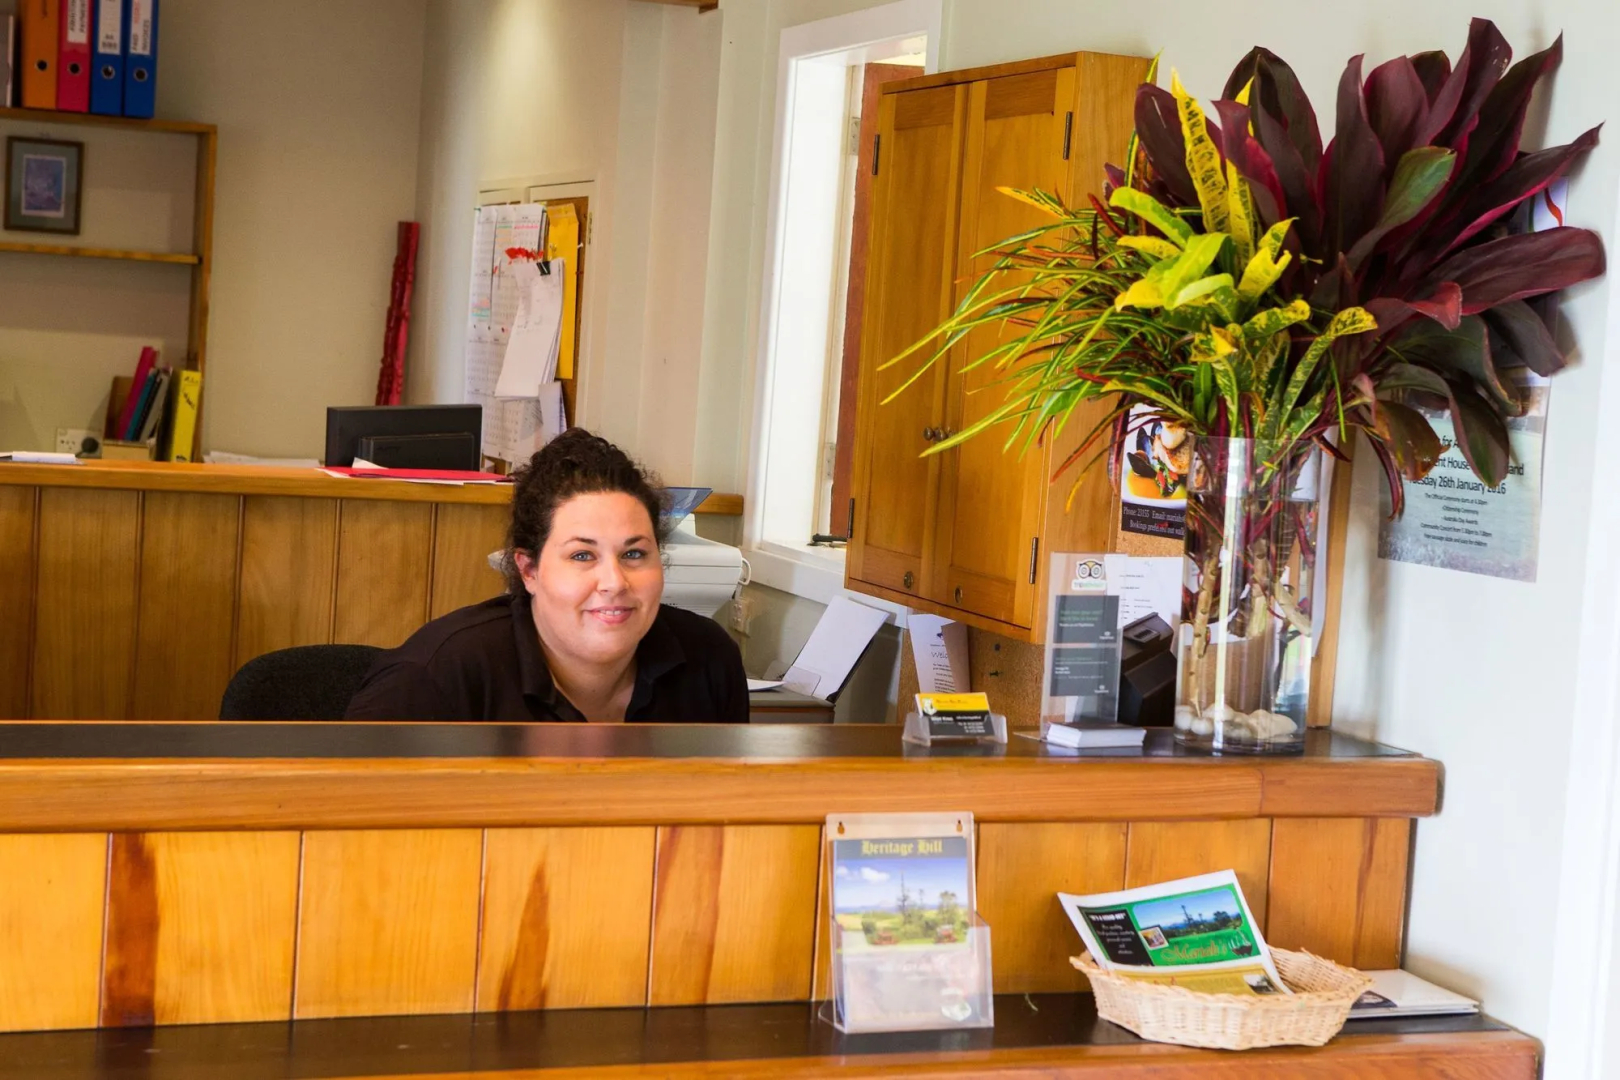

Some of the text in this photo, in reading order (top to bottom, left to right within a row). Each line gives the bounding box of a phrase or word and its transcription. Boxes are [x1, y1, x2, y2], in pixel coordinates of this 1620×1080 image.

[1442, 435, 1452, 447] for
[1438, 476, 1455, 487] 26th
[1456, 477, 1485, 495] January
[862, 838, 943, 856] Heritage Hill
